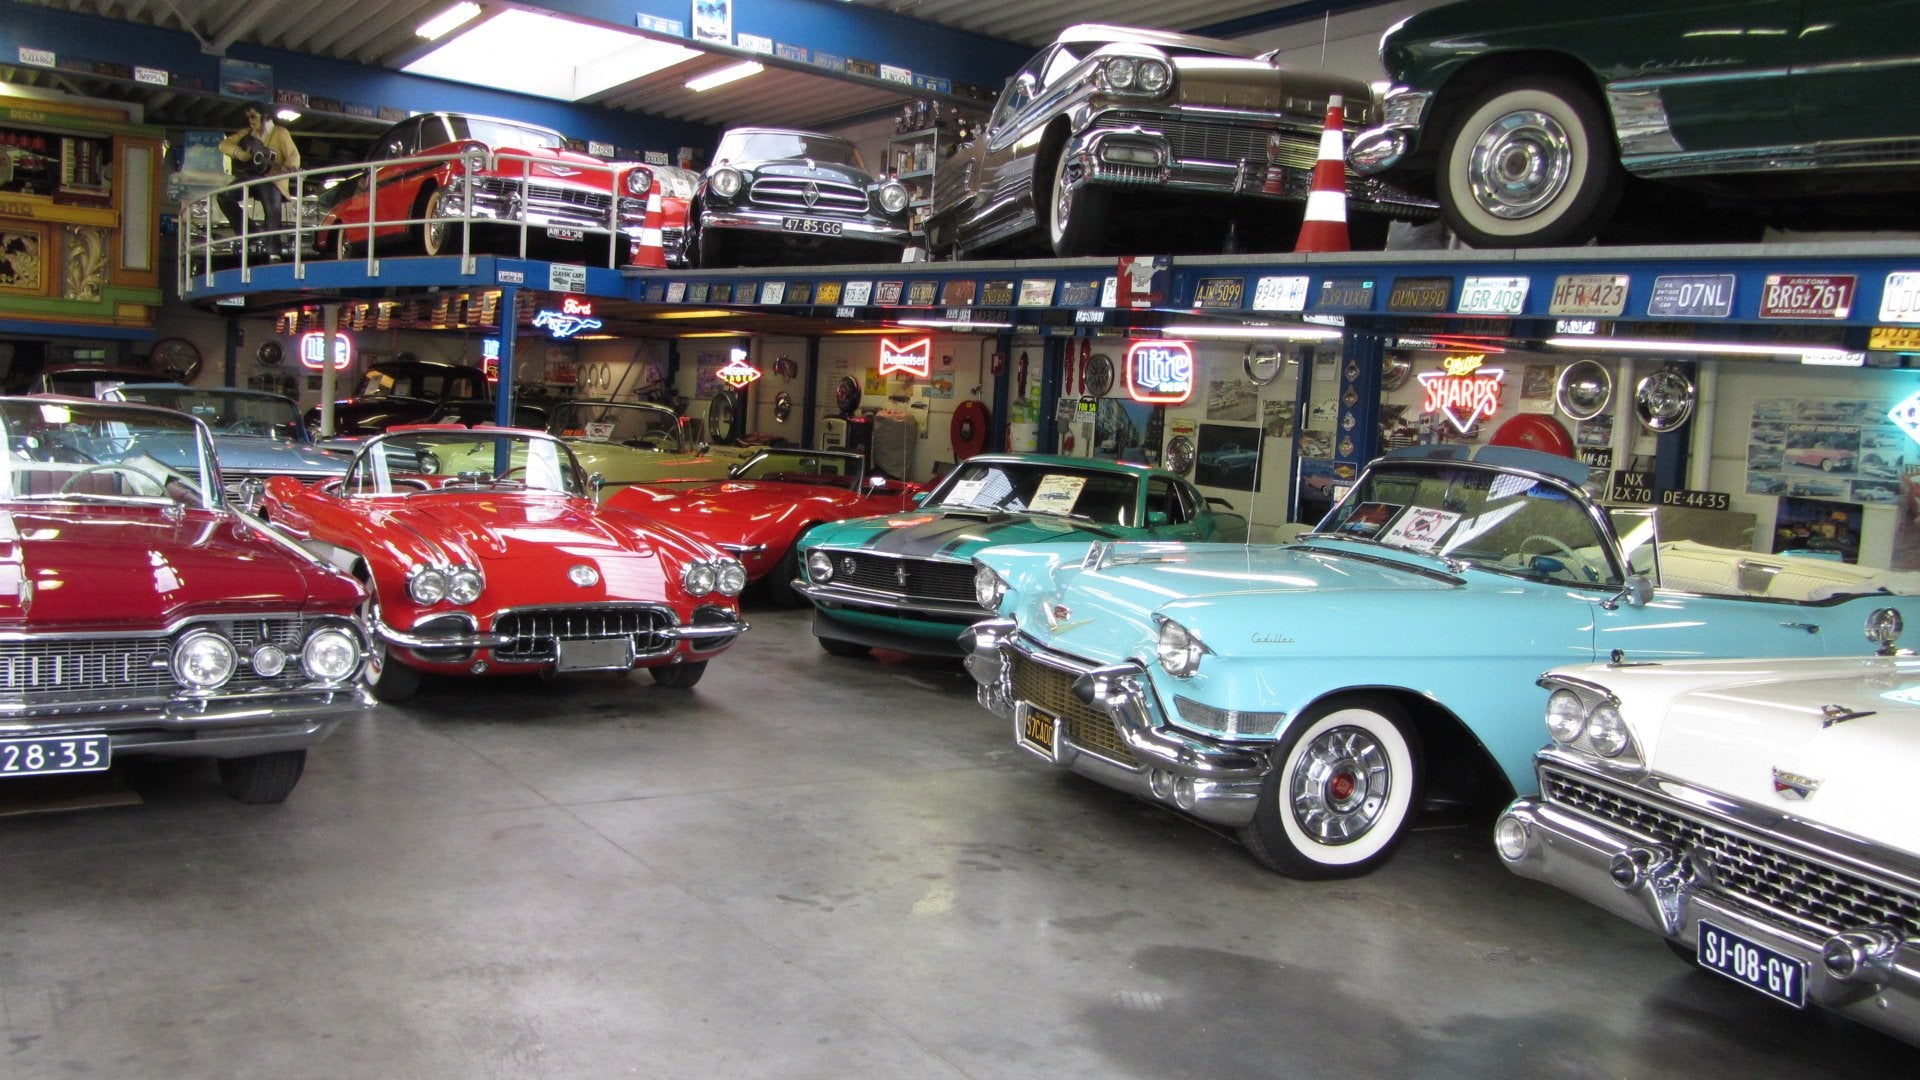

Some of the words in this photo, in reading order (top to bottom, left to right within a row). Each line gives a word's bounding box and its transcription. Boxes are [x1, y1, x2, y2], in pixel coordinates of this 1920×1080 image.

[784, 219, 841, 235] 47-85-GG
[552, 270, 571, 278] CLASSIC
[1461, 289, 1492, 308] LGR
[1493, 289, 1523, 309] 408
[1553, 284, 1585, 306] HFR
[1590, 284, 1623, 306] 423
[1678, 283, 1726, 308] 07NL
[1766, 285, 1804, 308] BRG
[1809, 285, 1846, 308] 761
[563, 298, 592, 315] Ford
[883, 350, 927, 367] Budweiser
[1443, 354, 1486, 376] Miller
[1136, 349, 1190, 388] Lite
[1624, 473, 1645, 487] NX
[1613, 486, 1651, 501] ZX-70
[1663, 490, 1726, 509] DE-44-35
[1251, 632, 1296, 643] Cadillac
[1705, 931, 1794, 998] SJ-08-GY
